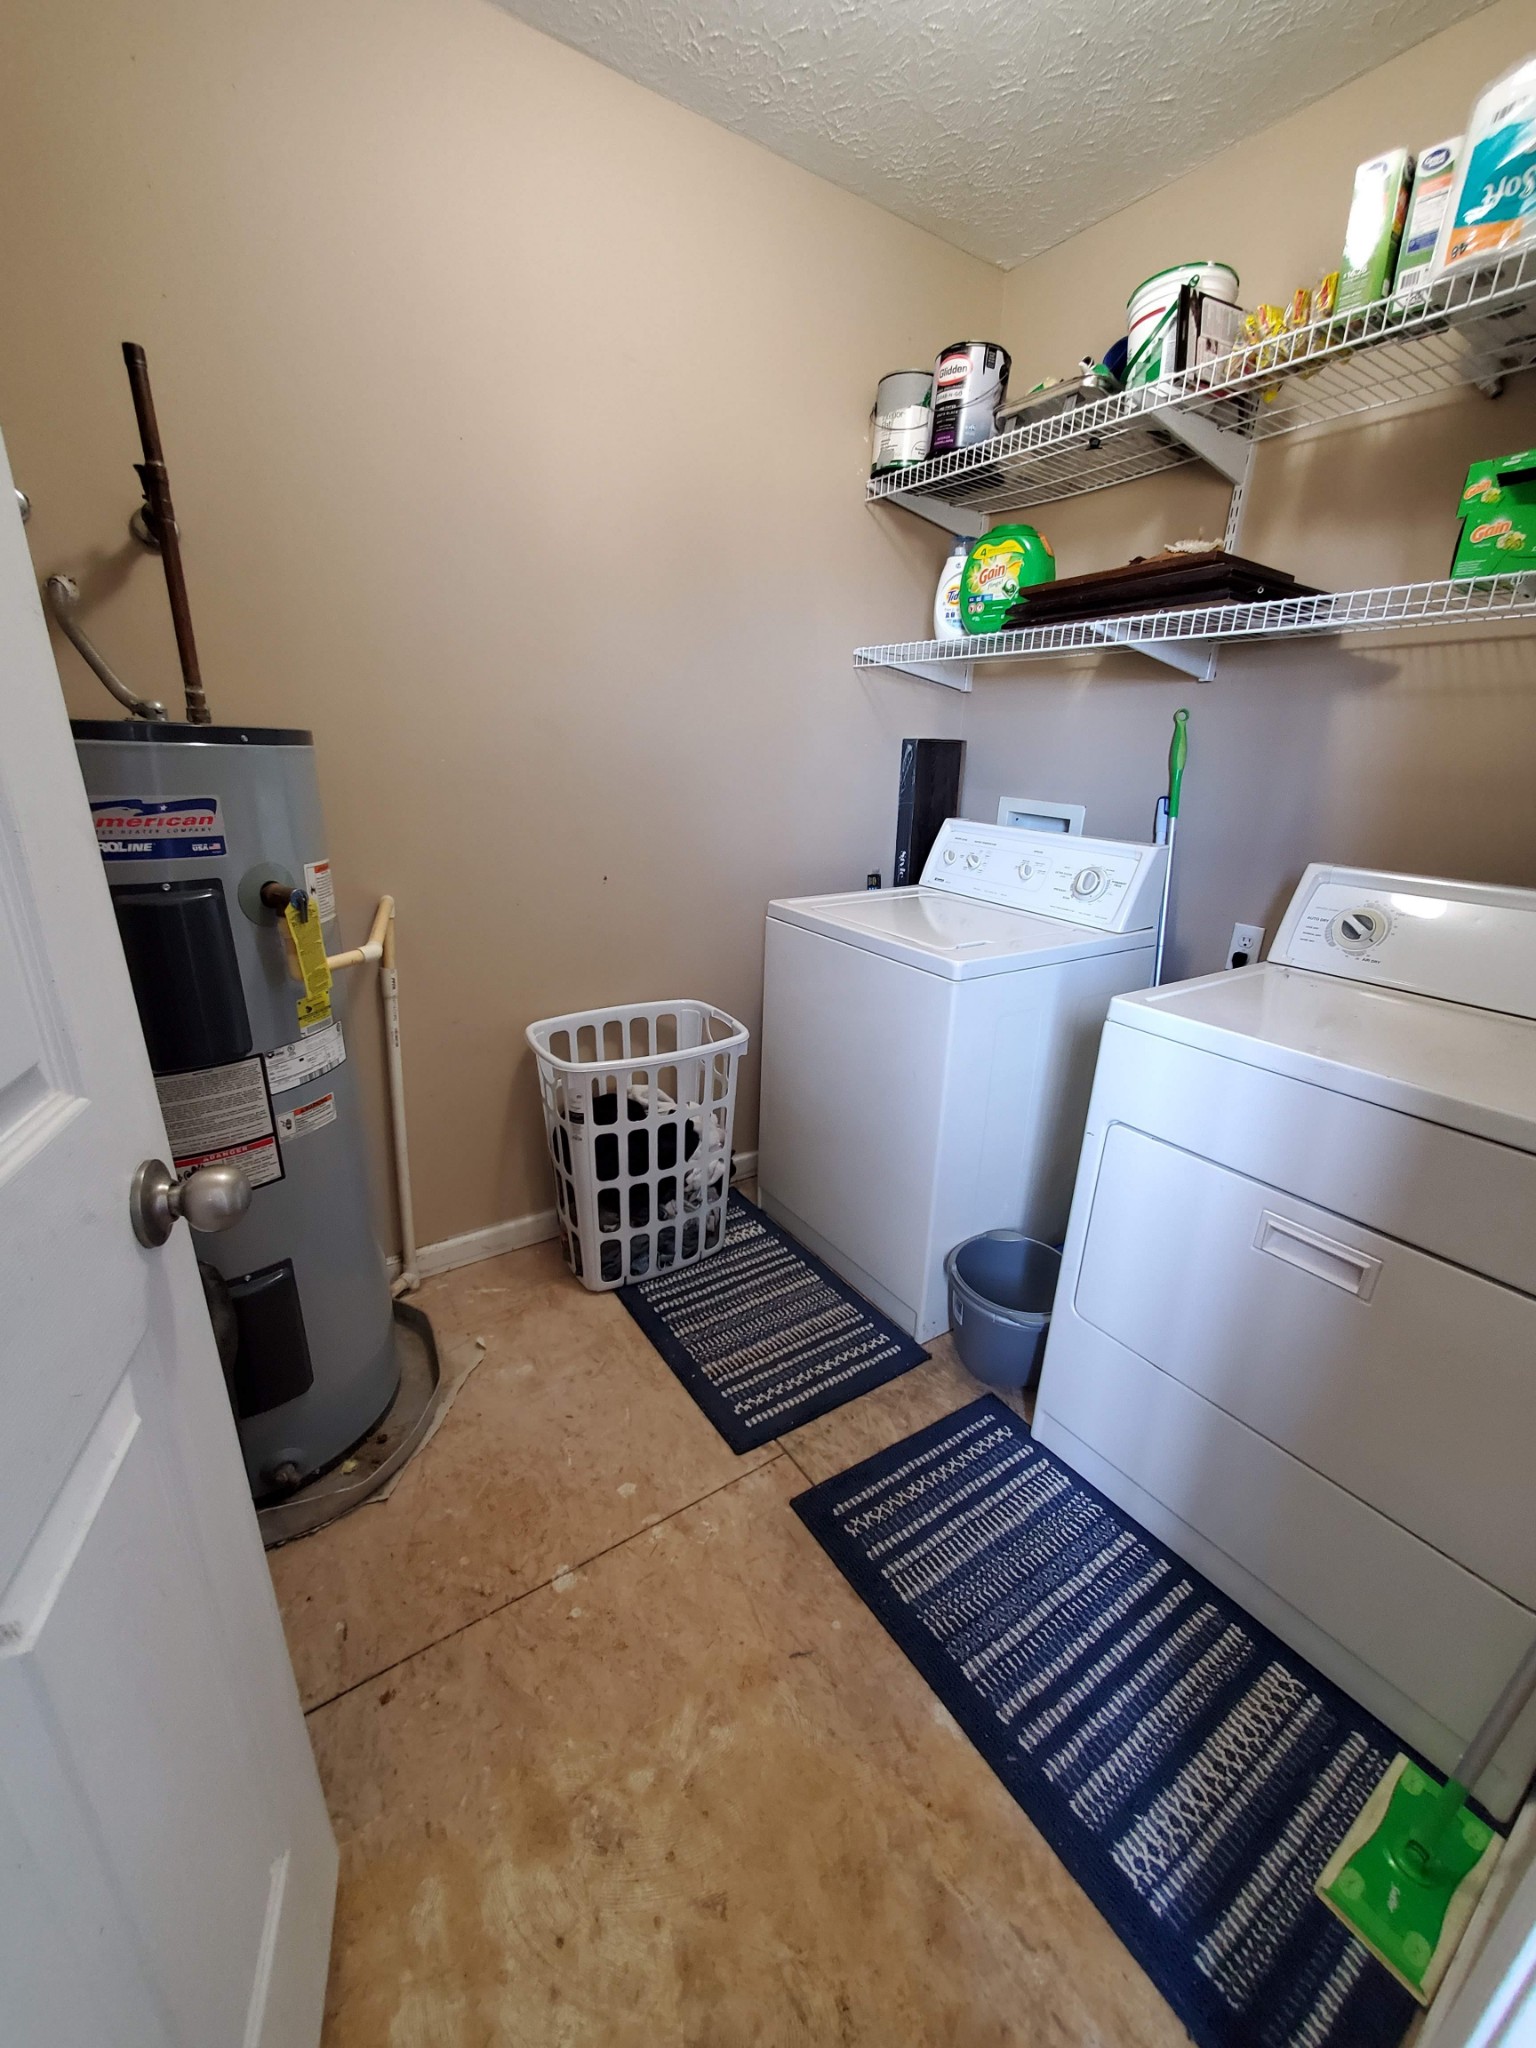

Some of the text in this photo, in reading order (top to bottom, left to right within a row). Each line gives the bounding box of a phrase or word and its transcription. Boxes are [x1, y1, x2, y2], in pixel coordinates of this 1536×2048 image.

[939, 364, 968, 379] Glidden
[1470, 520, 1512, 543] Gain
[979, 564, 1006, 585] Gain
[947, 589, 960, 604] Tid
[96, 815, 214, 828] merican
[98, 841, 153, 853] ROLINE
[209, 1146, 249, 1160] DANGER
